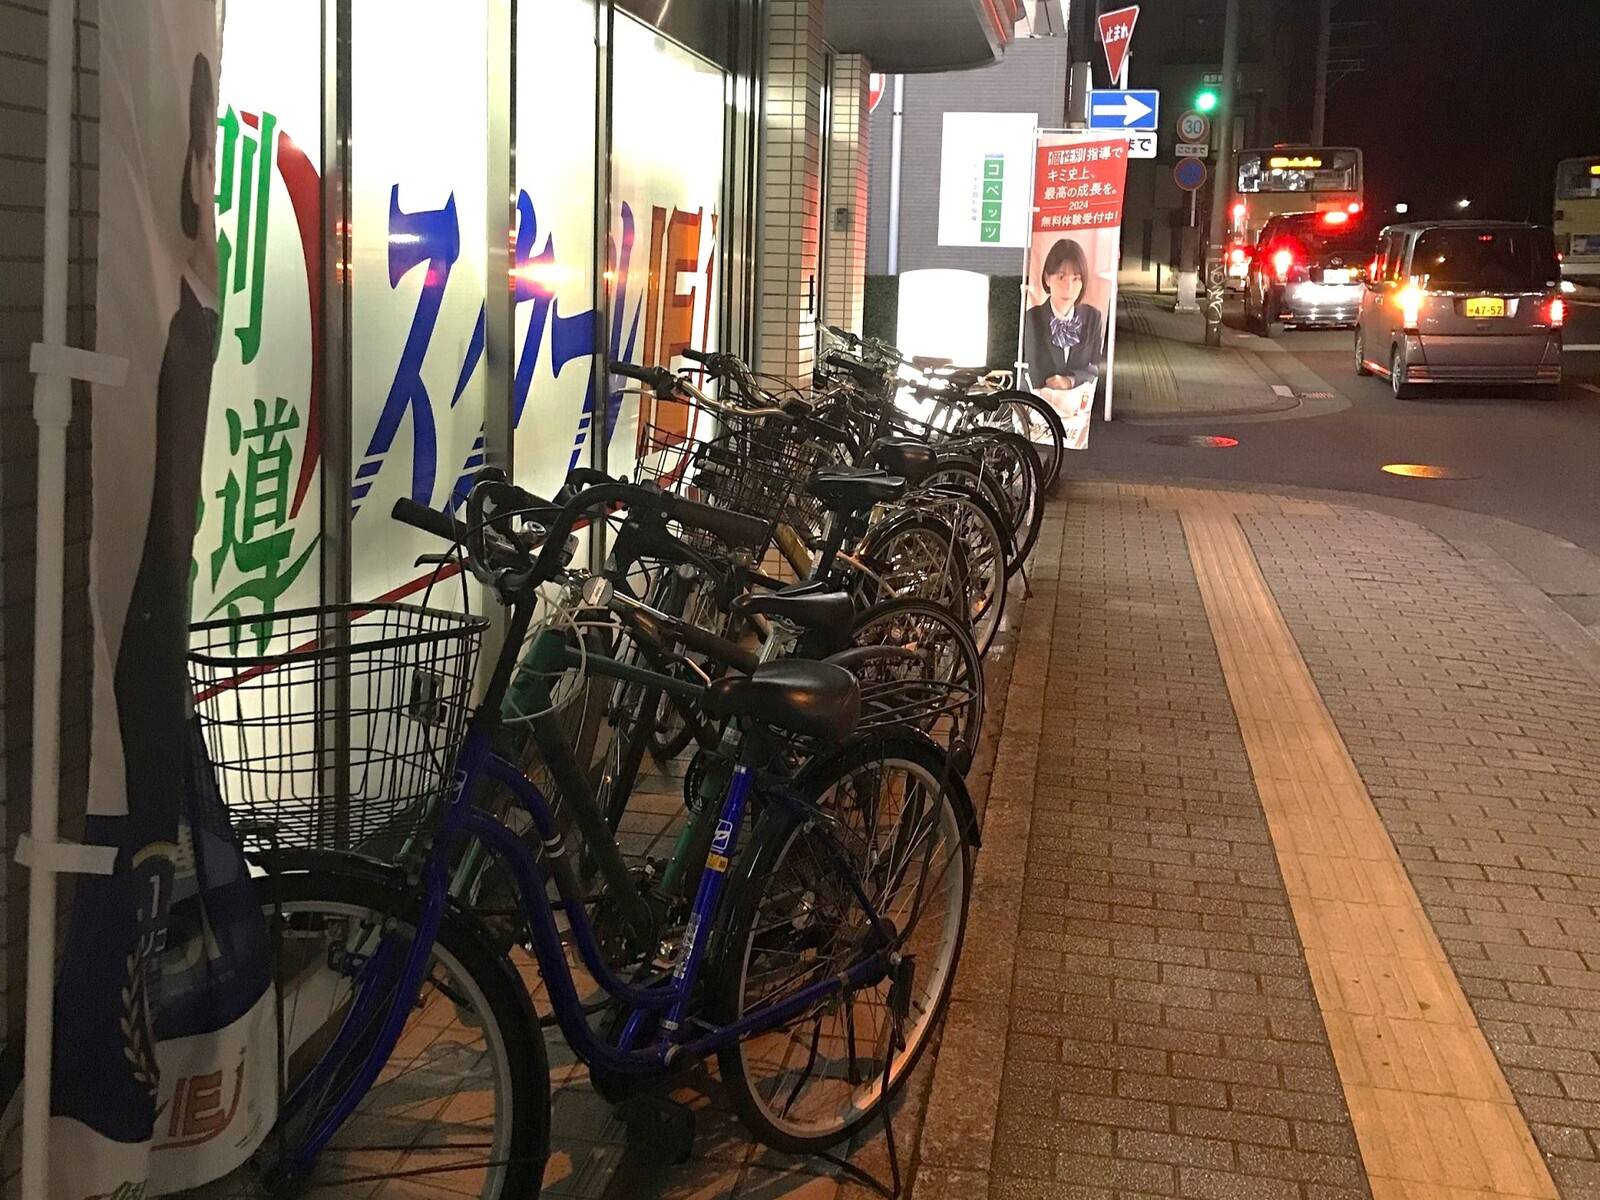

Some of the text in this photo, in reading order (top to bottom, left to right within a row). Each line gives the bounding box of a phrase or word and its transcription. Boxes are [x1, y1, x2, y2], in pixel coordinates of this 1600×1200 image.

[1105, 22, 1129, 43] 止まれ
[1183, 119, 1202, 135] 30
[1177, 146, 1205, 154] ここまで
[1044, 182, 1117, 200] 最高の成長を。
[984, 163, 1000, 239] コベッツ
[1068, 200, 1089, 211] 2024
